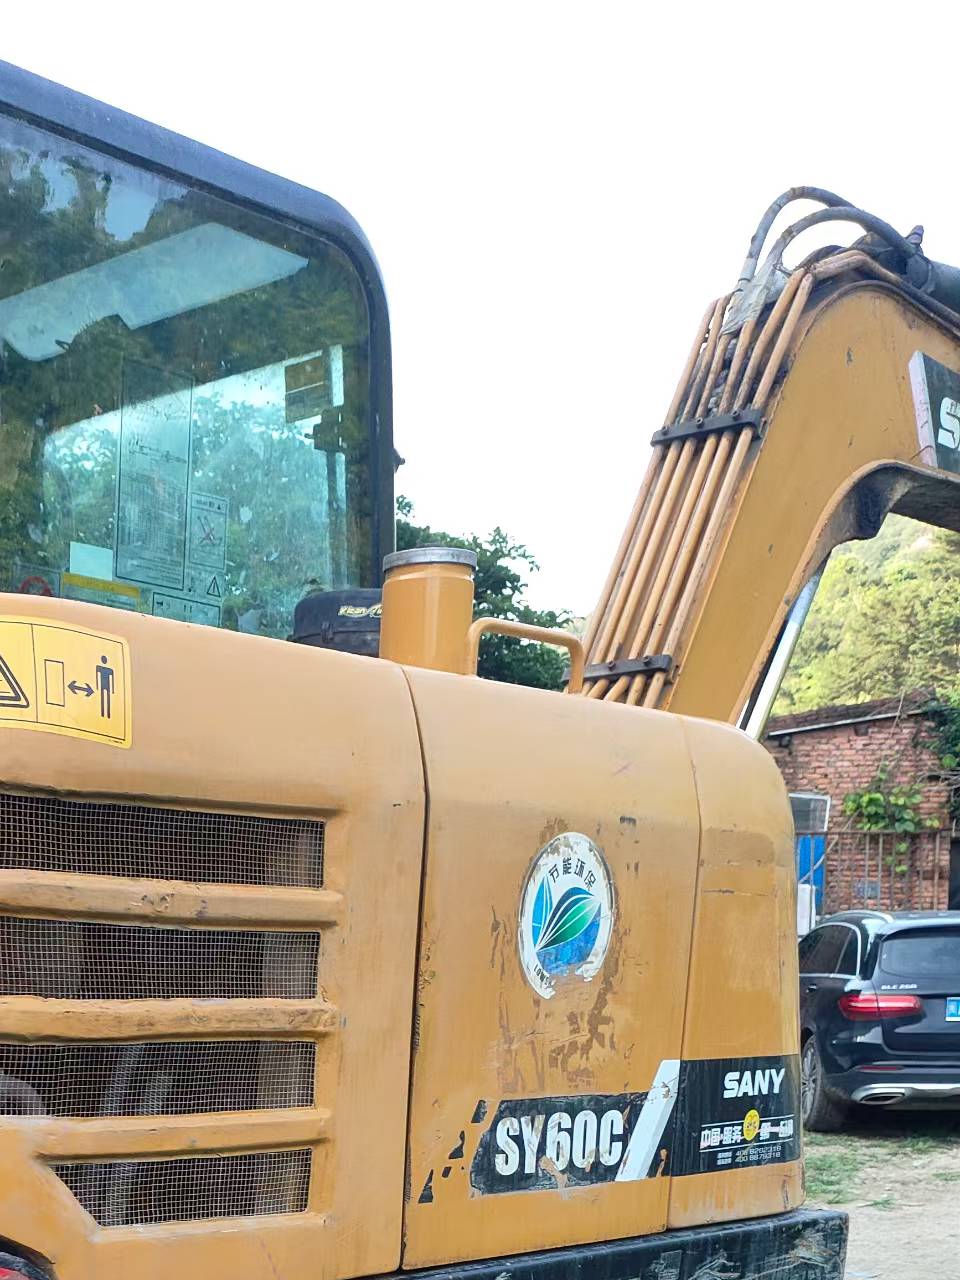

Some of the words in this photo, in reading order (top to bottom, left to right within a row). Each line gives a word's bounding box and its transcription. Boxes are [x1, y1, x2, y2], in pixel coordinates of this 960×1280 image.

[937, 397, 960, 449] S
[723, 1068, 786, 1099] SANY
[494, 1109, 624, 1176] SY60C
